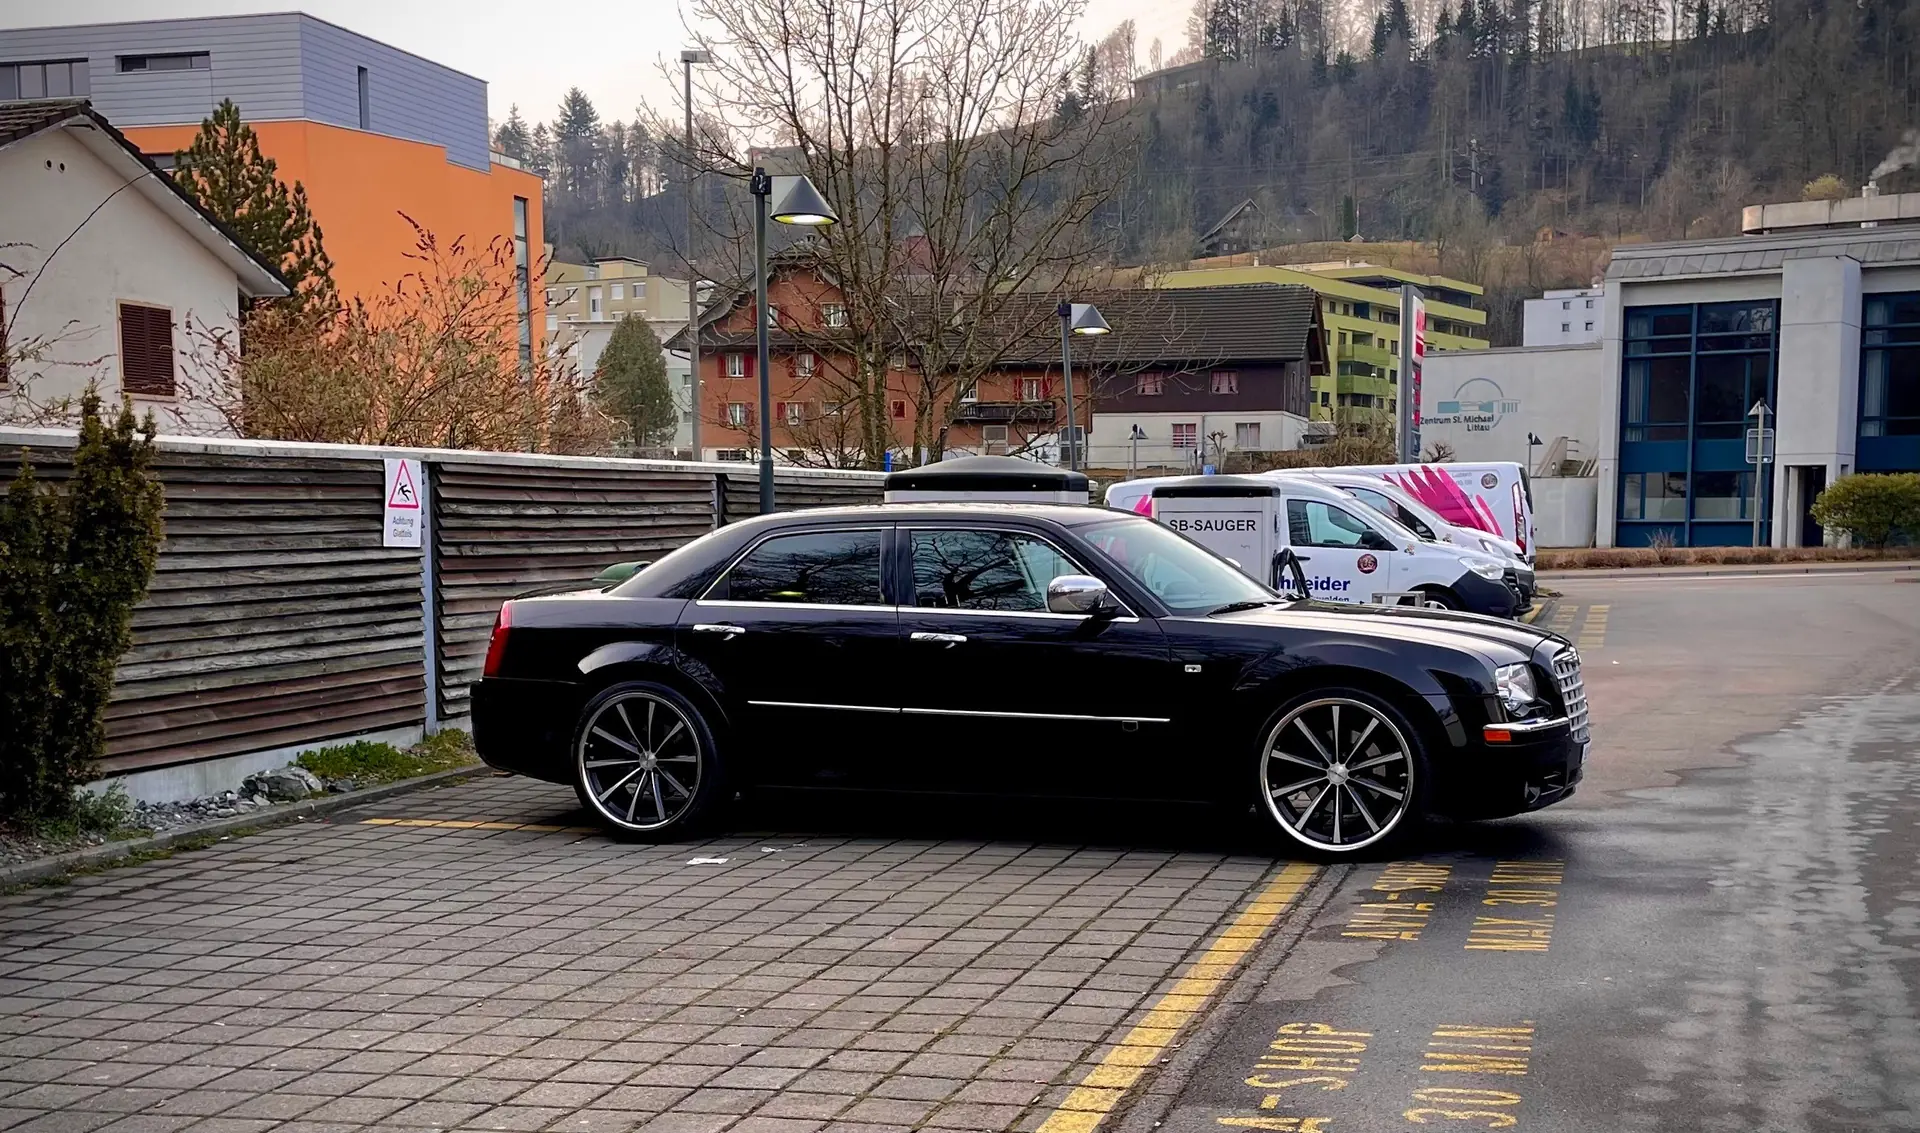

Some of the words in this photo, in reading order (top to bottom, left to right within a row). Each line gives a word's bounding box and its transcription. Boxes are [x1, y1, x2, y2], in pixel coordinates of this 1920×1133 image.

[1420, 417, 1451, 425] Zentrum
[1463, 414, 1494, 423] Michael
[1466, 424, 1490, 432] Littau
[1169, 519, 1256, 531] SB-SAUGER
[1402, 1087, 1523, 1128] 30
